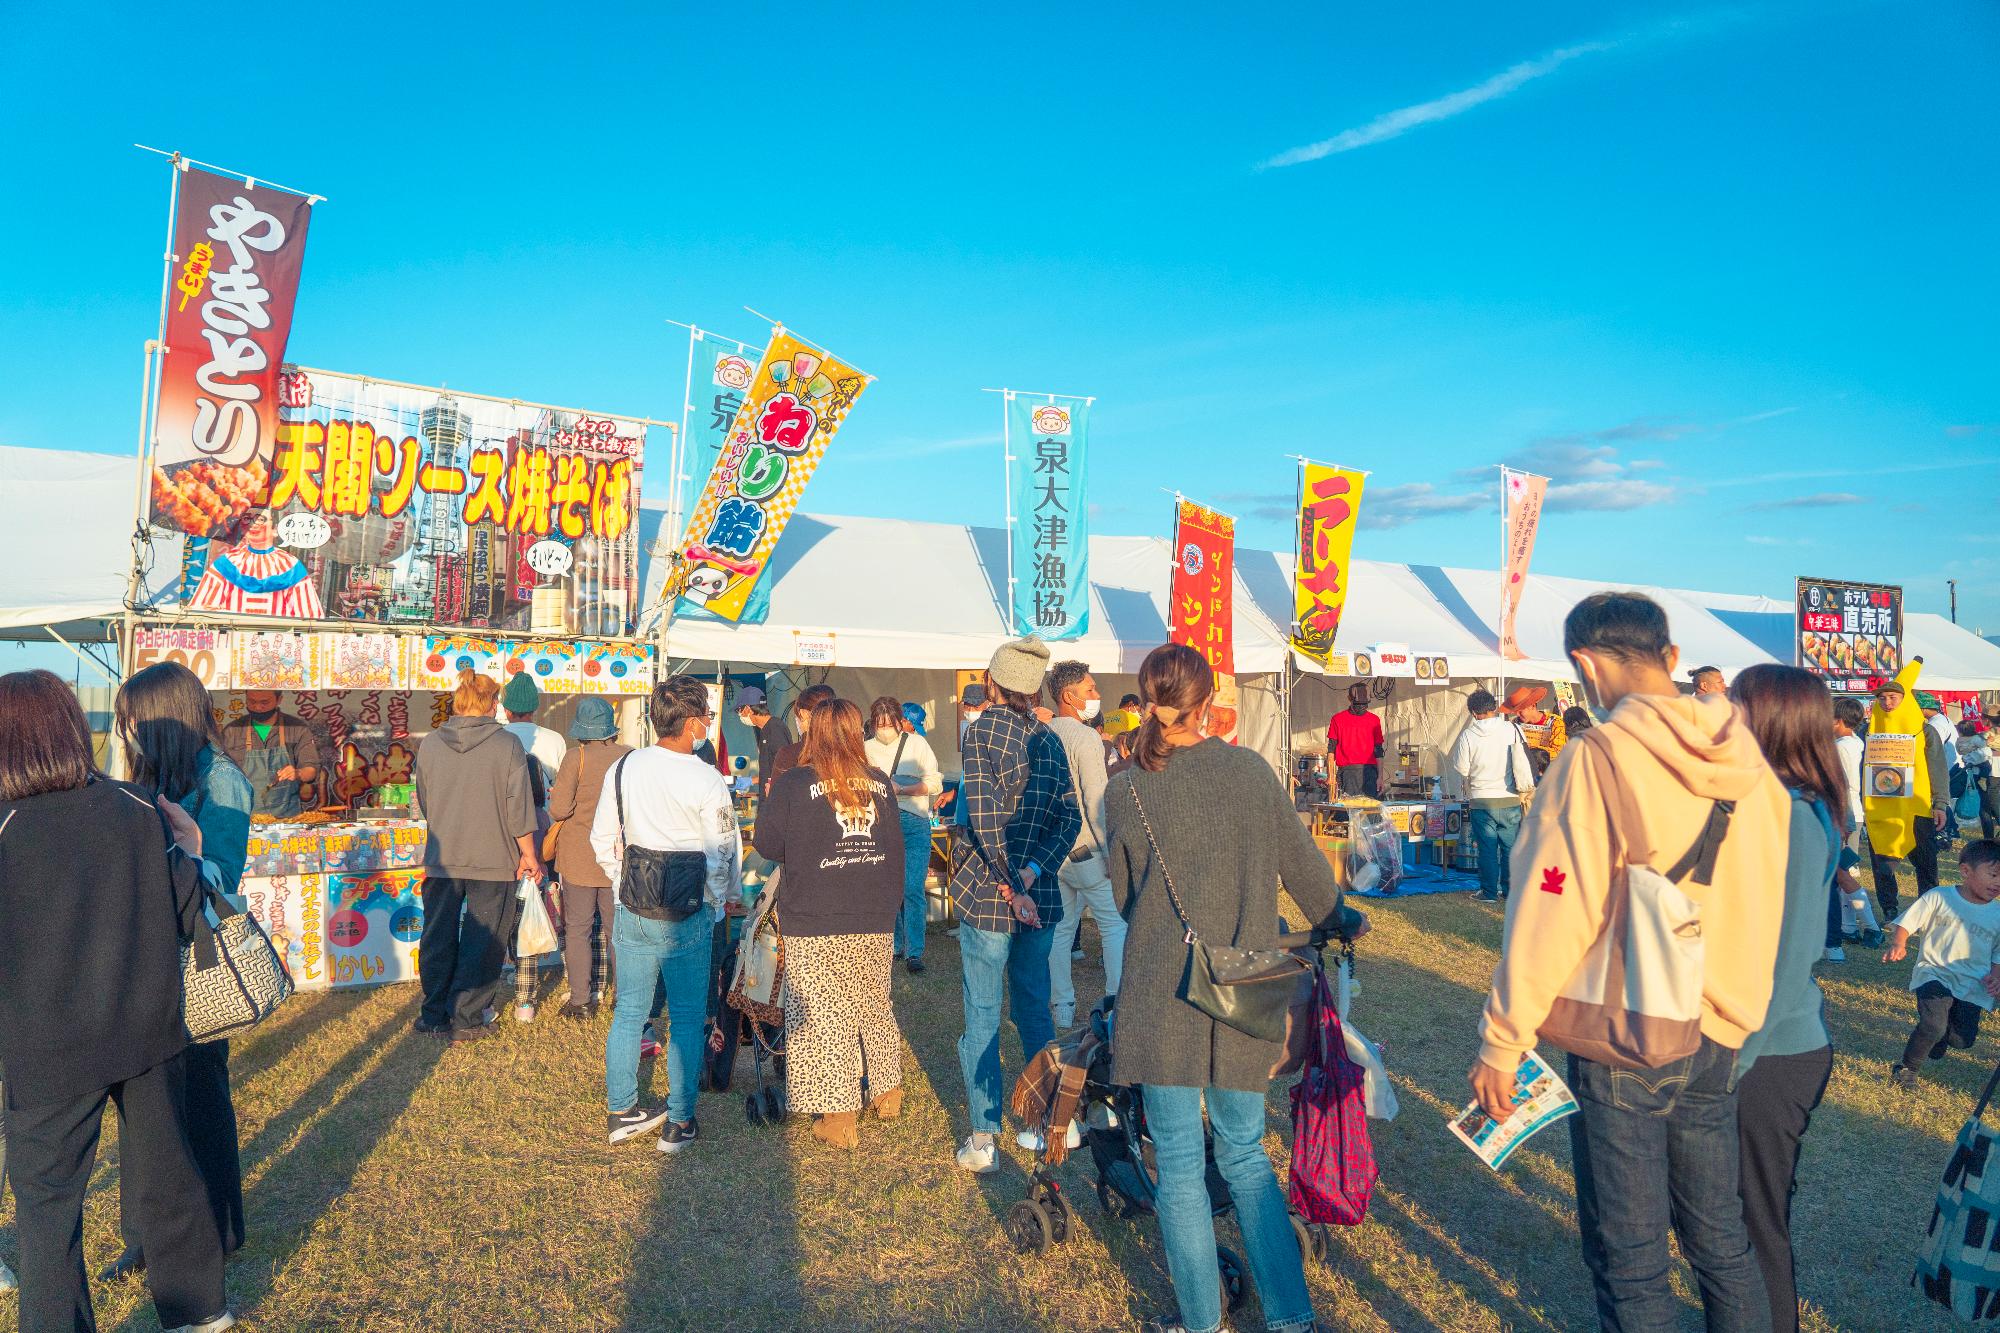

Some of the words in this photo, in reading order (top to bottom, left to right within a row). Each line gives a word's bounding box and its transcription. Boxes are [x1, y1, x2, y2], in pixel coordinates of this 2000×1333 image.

[185, 248, 210, 289] うまい
[192, 196, 287, 467] やきとり
[576, 416, 617, 434] 幻の
[267, 418, 635, 540] 天閣ソース焼そば
[703, 394, 819, 561] ねり飴
[285, 518, 326, 531] めっちゃ
[1032, 437, 1070, 628] 泉大津漁協
[1299, 475, 1351, 633] ラーメン
[1843, 605, 1892, 635] 直売所
[434, 639, 498, 654] みずあめ
[514, 643, 577, 656] みずあめ
[809, 778, 839, 800] RODE
[820, 857, 847, 869] Quality
